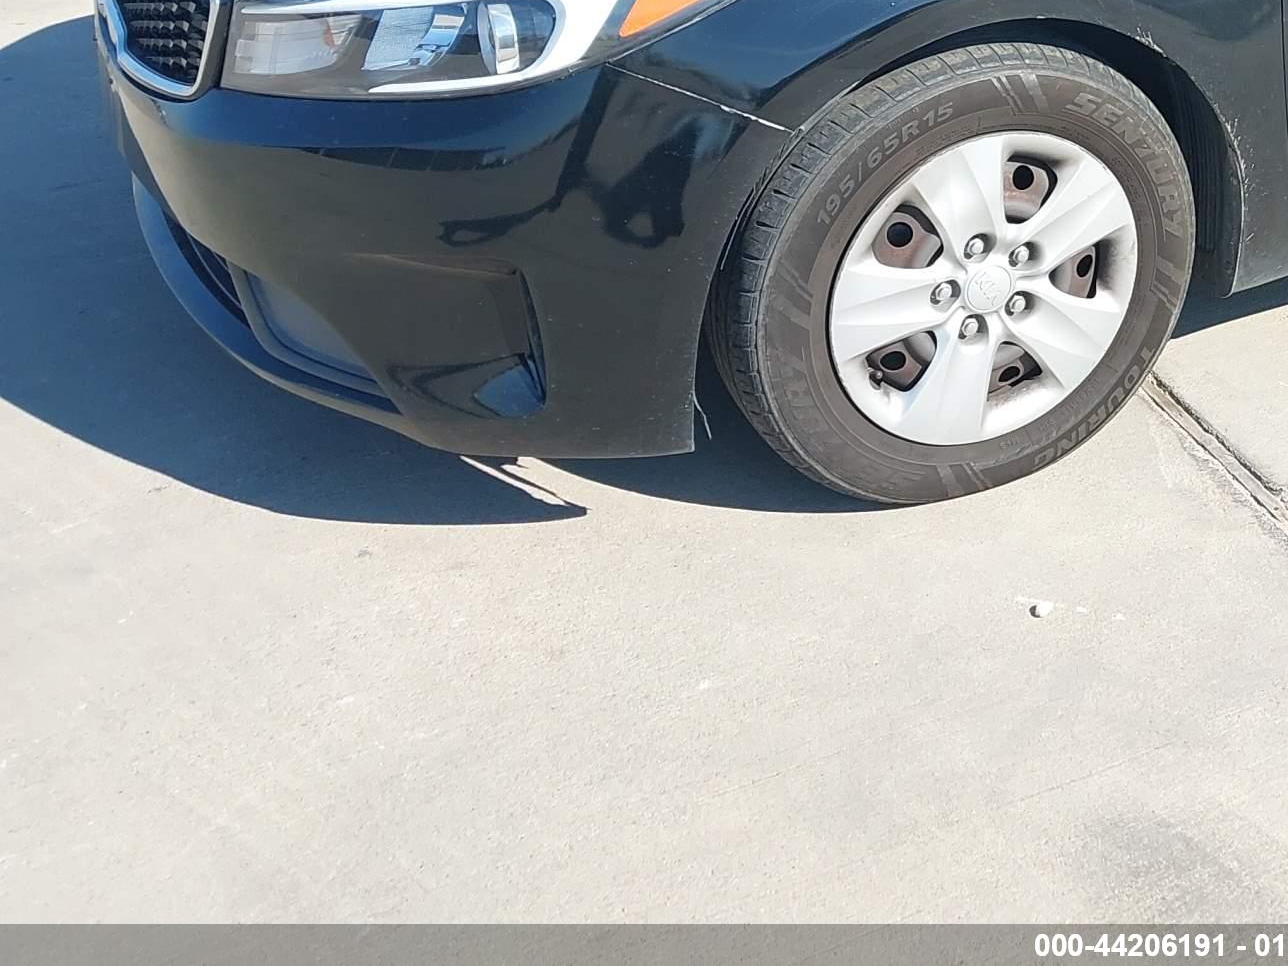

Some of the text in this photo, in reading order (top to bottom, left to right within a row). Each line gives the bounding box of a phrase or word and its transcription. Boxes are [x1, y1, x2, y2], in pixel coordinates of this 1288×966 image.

[815, 100, 956, 226] 195/65R15
[1066, 90, 1184, 234] SENTURY
[1032, 345, 1158, 468] TOURING
